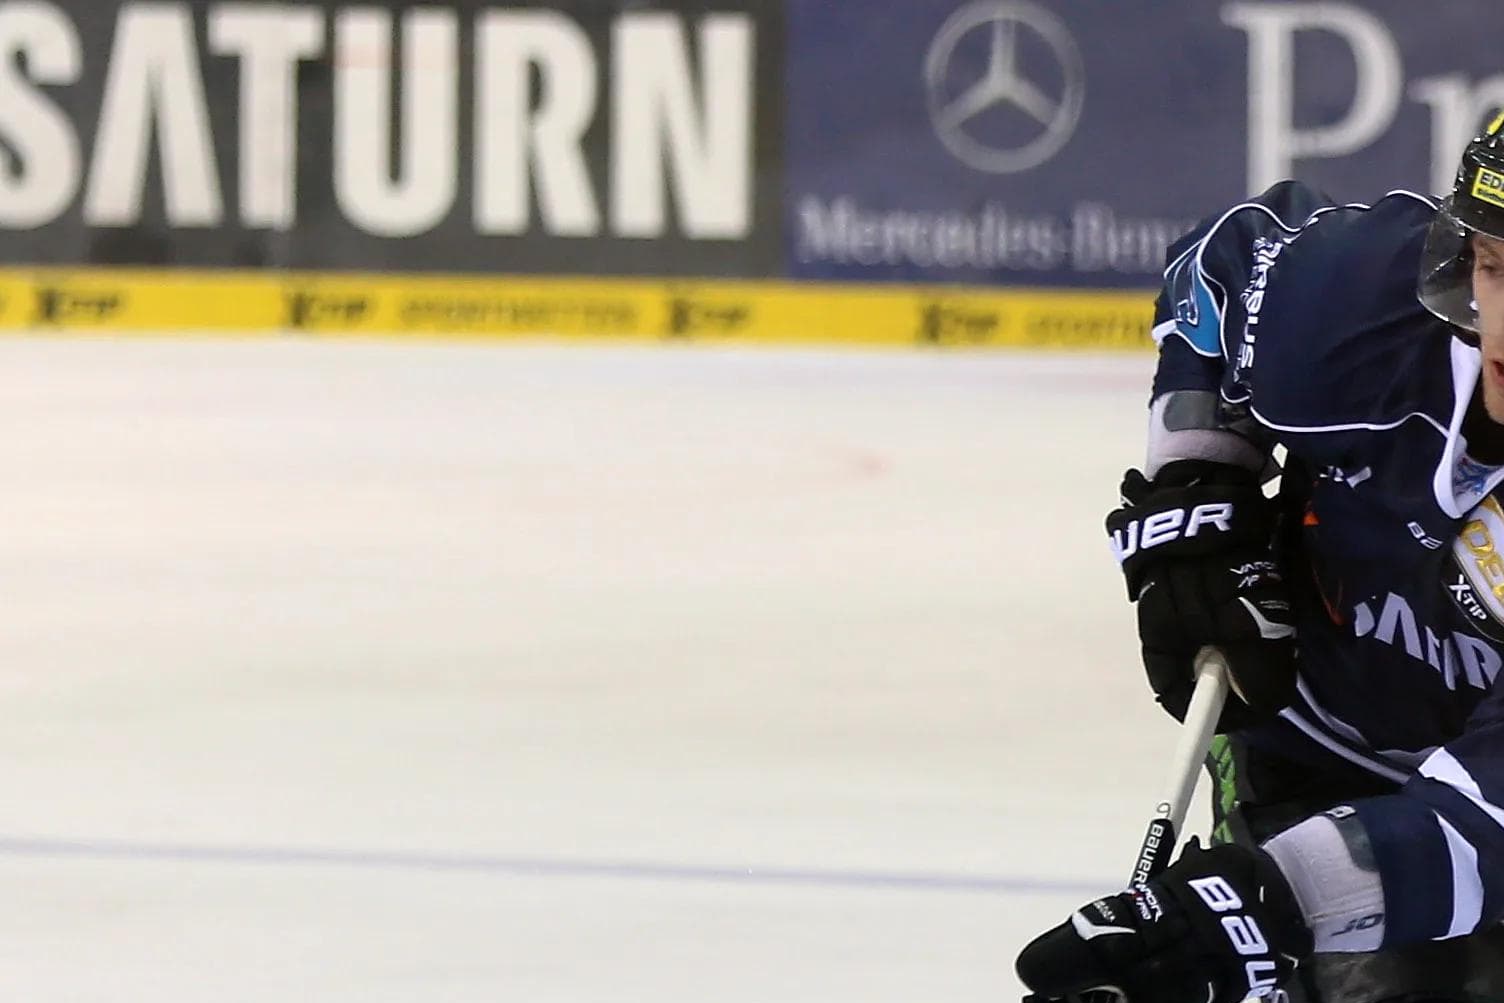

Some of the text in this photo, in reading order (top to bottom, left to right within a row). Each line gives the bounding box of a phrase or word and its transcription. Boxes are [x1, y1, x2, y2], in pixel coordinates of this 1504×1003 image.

[0, 0, 754, 240] SATURN
[801, 197, 1193, 274] Mercedes-Ben
[1108, 502, 1234, 560] UeR
[1188, 876, 1278, 1000] BaU
